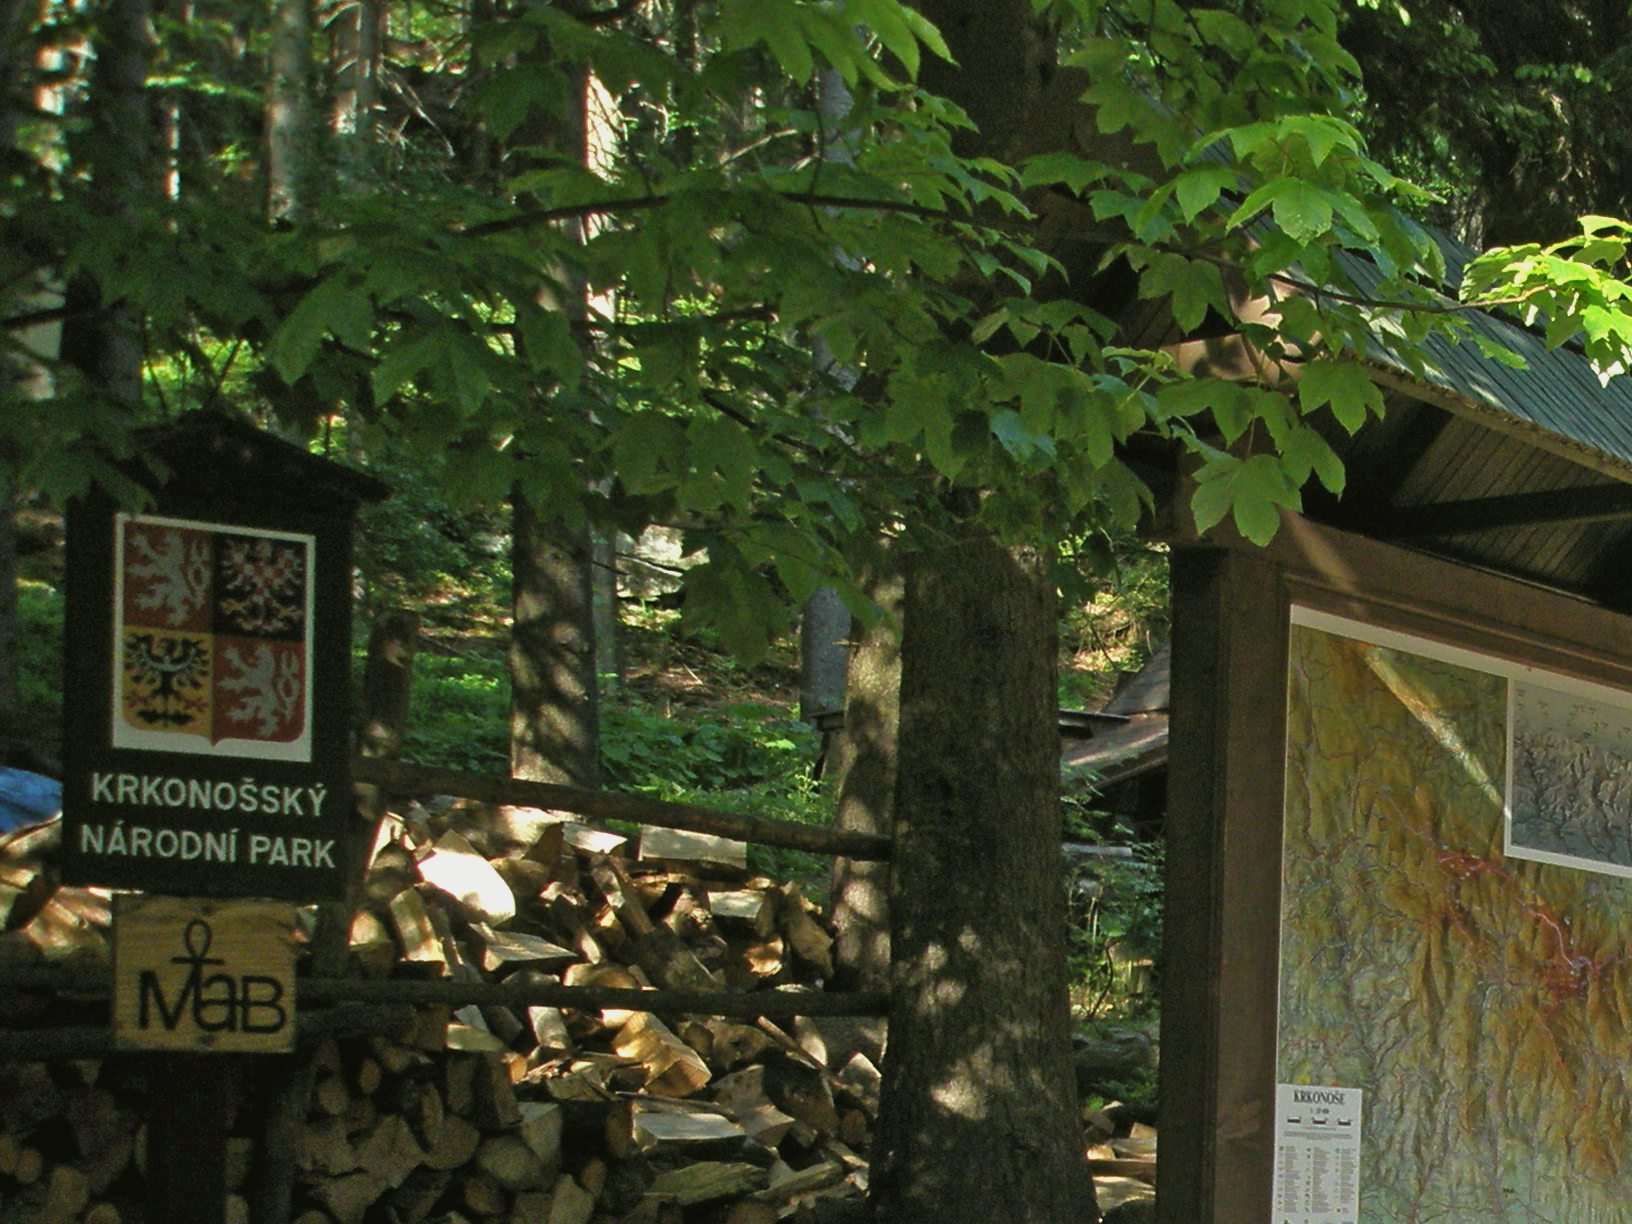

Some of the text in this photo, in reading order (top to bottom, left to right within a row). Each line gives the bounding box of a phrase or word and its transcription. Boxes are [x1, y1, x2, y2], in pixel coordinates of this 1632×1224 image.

[92, 772, 327, 816] KRKONOŠSKÝ
[81, 820, 336, 868] NÁRODNÍ PARK
[1294, 1089, 1345, 1105] KRKONOŠE
